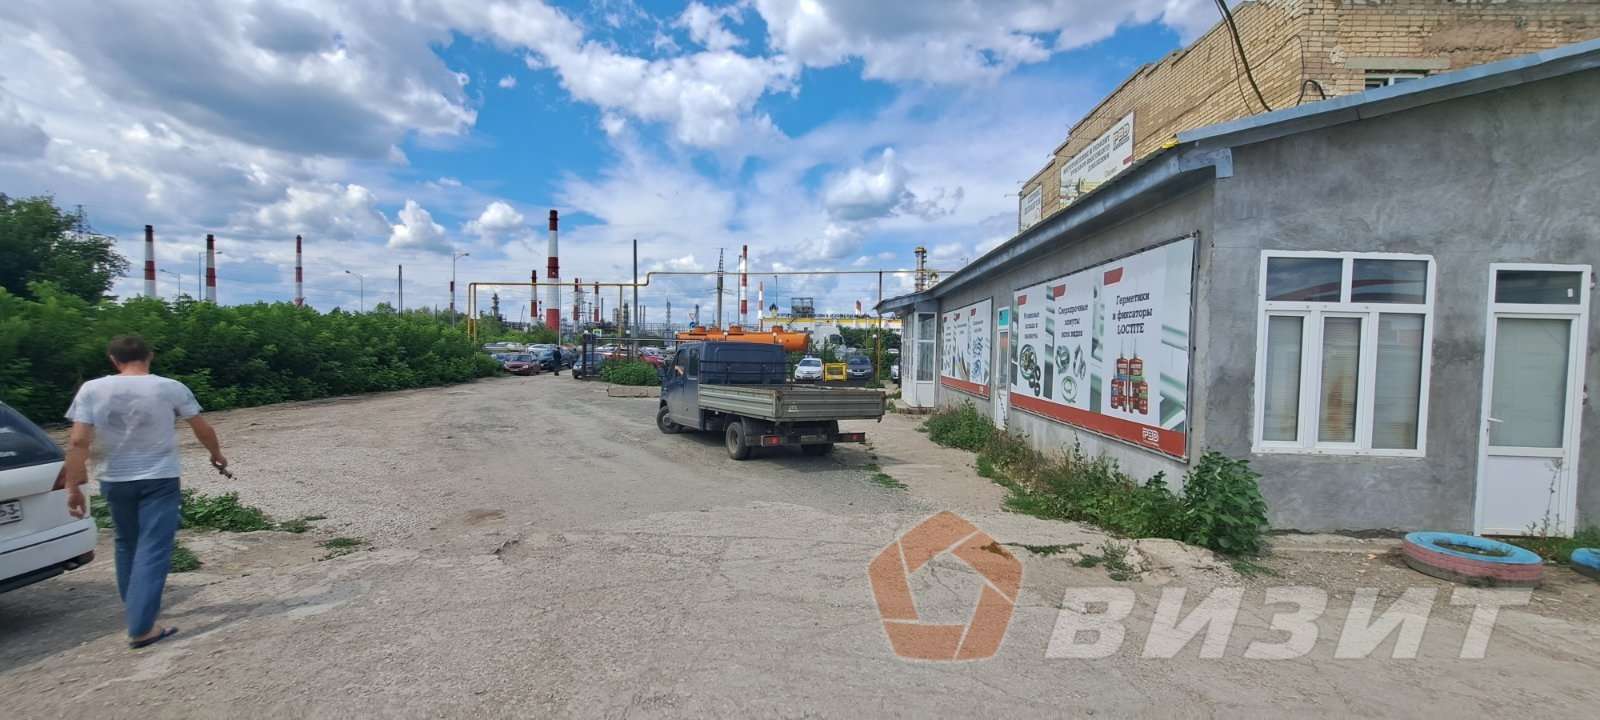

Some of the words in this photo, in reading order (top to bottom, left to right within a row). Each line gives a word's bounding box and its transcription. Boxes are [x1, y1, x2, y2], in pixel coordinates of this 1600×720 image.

[1116, 292, 1150, 306] Герметики
[1117, 308, 1153, 322] фиксаторы
[1117, 323, 1145, 335] LOCTITE
